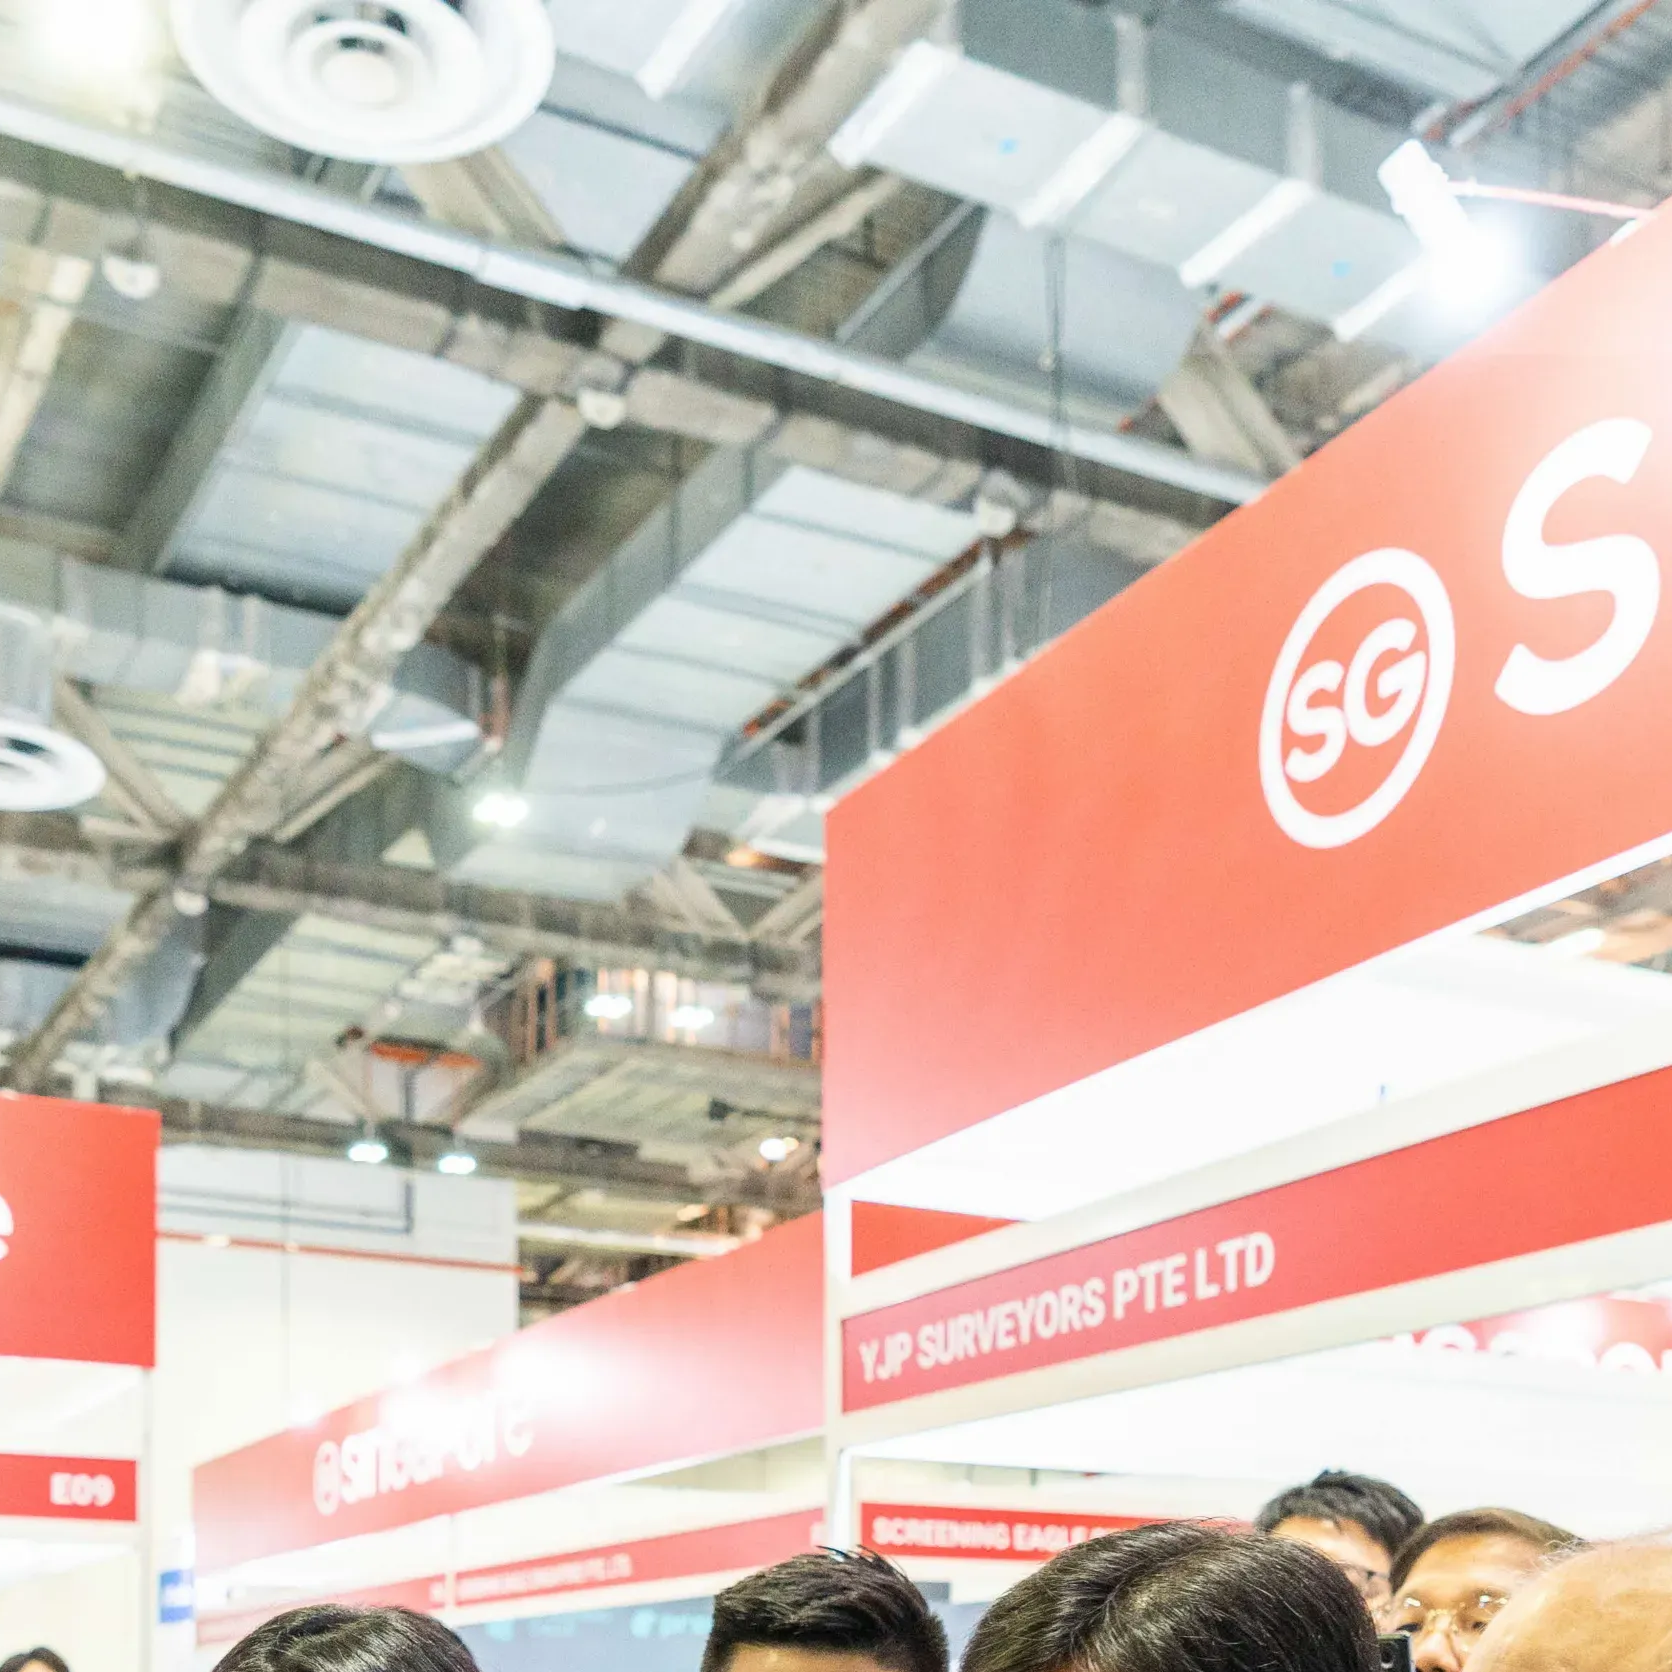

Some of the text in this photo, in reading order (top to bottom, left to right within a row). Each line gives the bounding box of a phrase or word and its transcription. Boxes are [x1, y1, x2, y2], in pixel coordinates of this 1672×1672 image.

[1285, 617, 1427, 784] SG
[858, 1232, 1275, 1383] YJP SURVEYORS PTE LTD
[49, 1471, 116, 1507] E09
